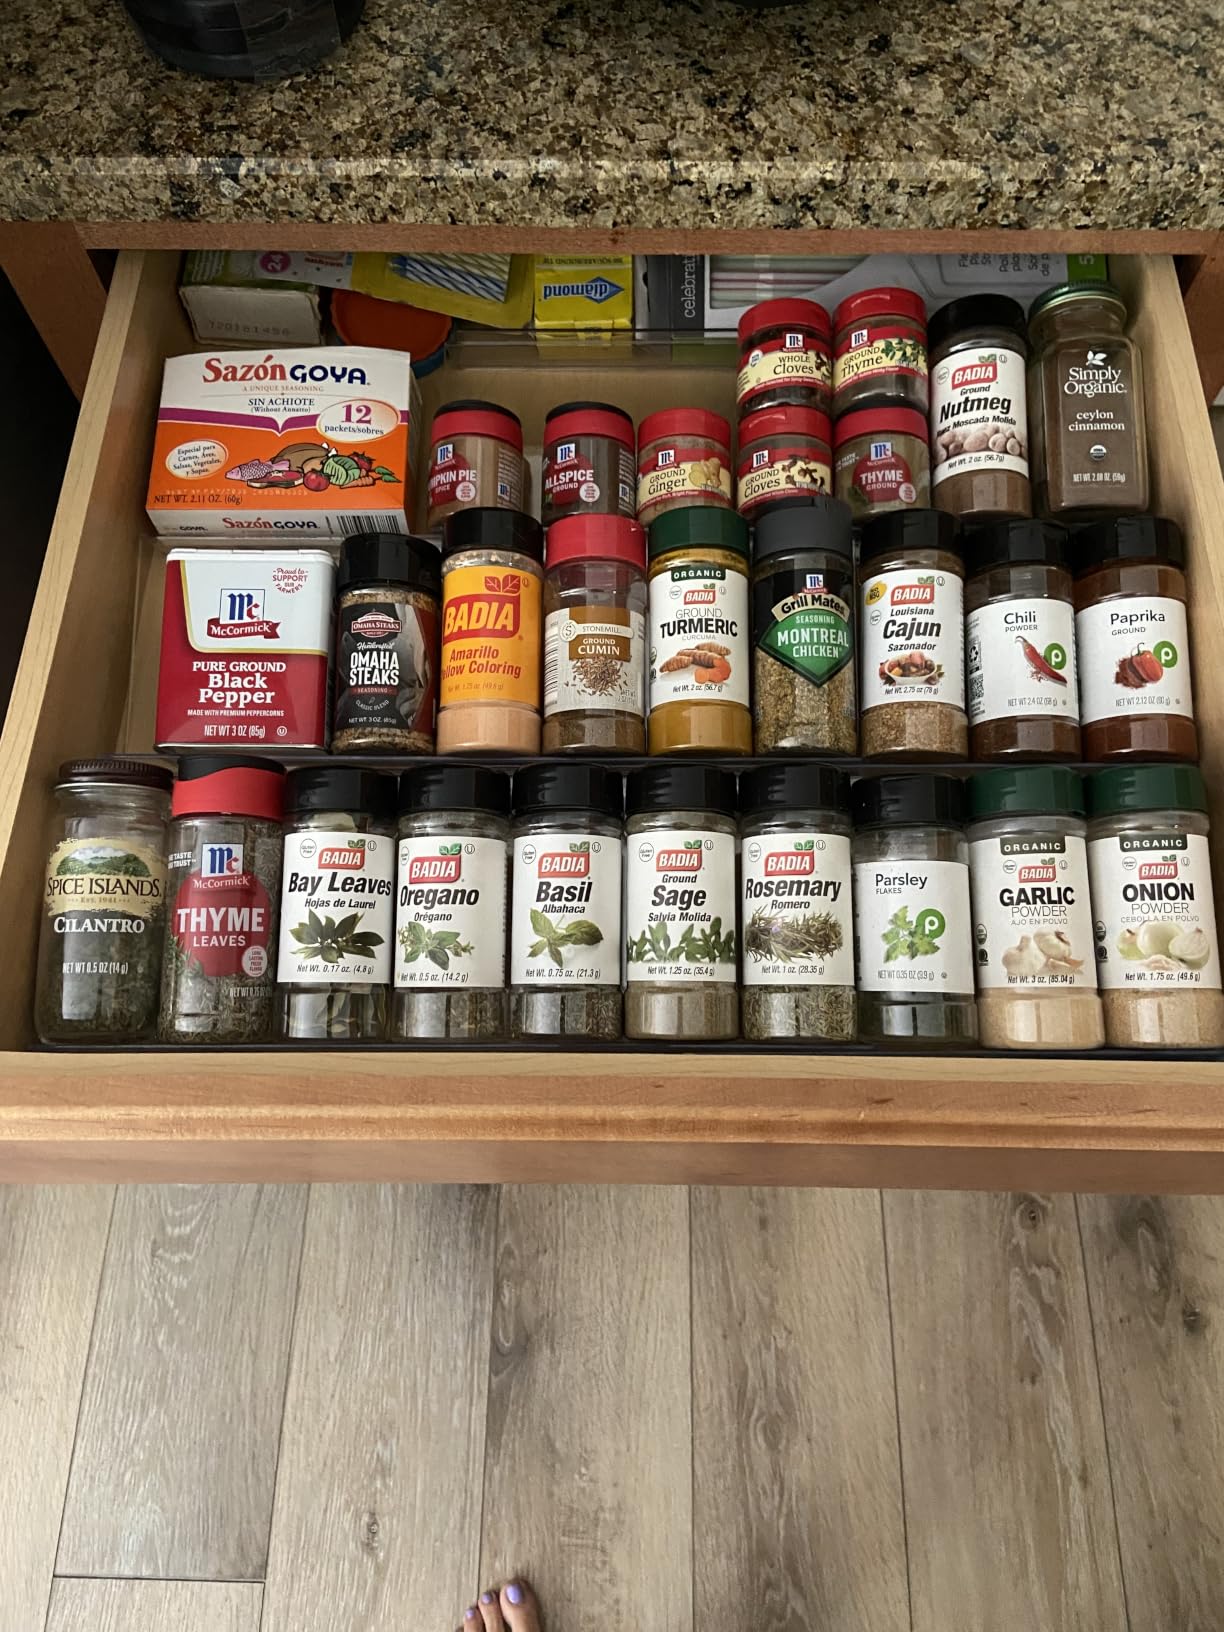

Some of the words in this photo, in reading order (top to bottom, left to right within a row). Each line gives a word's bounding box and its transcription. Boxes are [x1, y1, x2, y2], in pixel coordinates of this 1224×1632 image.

[543, 283, 609, 300] diamond
[778, 355, 810, 364] WHOLE
[844, 346, 881, 366] GROUND
[203, 354, 287, 383] Sazón
[289, 364, 368, 386] GOYA
[773, 363, 814, 375] Cloves
[841, 356, 883, 378] Thyme
[954, 365, 993, 385] BADIA
[1068, 366, 1122, 384] Simply
[960, 385, 991, 396] Ground
[1064, 381, 1125, 398] Organic
[248, 398, 268, 406] SIN
[270, 398, 316, 407] ACHIOTE
[250, 406, 278, 414] (Without
[341, 403, 373, 425] 12
[940, 396, 1012, 424] Nutmeg
[1076, 410, 1113, 422] ceylon
[952, 416, 989, 430] Moscada
[992, 416, 1016, 426] Molida
[1068, 422, 1125, 431] cinnamon
[324, 424, 385, 437] packets/sobres
[458, 469, 478, 482] PIE
[545, 469, 594, 491] ALLSPICE
[649, 469, 686, 485] GROUND
[745, 468, 780, 487] GROUND
[860, 469, 904, 486] THYME
[552, 482, 579, 494] GROUND
[648, 478, 687, 496] Ginger
[744, 478, 781, 499] Cloves
[866, 482, 898, 491] GROUND
[153, 494, 172, 504] NET
[174, 494, 188, 504] WT.
[206, 494, 222, 504] OZ.
[222, 517, 273, 530] Sazón
[273, 518, 317, 530] GOYA
[277, 567, 297, 575] Proud
[673, 570, 722, 579] ORGANIC
[686, 590, 713, 602] BADIA
[893, 587, 931, 602] BADIA
[780, 594, 809, 614] Grill
[811, 594, 845, 616] Mates
[890, 606, 935, 617] Louisiana
[444, 601, 515, 637] BADIA
[675, 607, 723, 619] GROUND
[1004, 611, 1036, 625] Chili
[1110, 610, 1166, 626] Paprika
[353, 621, 376, 630] OMAHA
[377, 621, 399, 629] STEAKS
[795, 615, 835, 625] SEASONING
[210, 623, 272, 636] McCormick
[582, 625, 620, 633] STONEMILL
[660, 618, 738, 639] TURMERIC
[882, 618, 942, 641] Cajun
[1111, 627, 1147, 636] GROUND
[777, 628, 849, 648] MONTREAL
[577, 645, 620, 656] CUMIN
[792, 646, 839, 659] CHICKEN
[887, 642, 937, 652] Sazonador
[350, 651, 400, 670] OMAHA
[450, 646, 499, 662] Amarillo
[192, 661, 227, 672] PURE
[229, 661, 287, 672] GROUND
[469, 660, 521, 680] Coloring
[207, 672, 268, 689] Black
[350, 668, 400, 686] STEAKS
[198, 688, 275, 709] Pepper
[204, 724, 217, 737] NET
[218, 724, 230, 737] WT
[237, 724, 247, 737] OZ
[1003, 842, 1061, 853] ORGANIC
[1123, 839, 1182, 849] ORGANIC
[174, 851, 193, 861] TASTE
[321, 850, 361, 866] BADIA
[659, 853, 699, 868] BADIA
[411, 860, 456, 879] BADIA
[541, 856, 586, 873] BADIA
[766, 855, 811, 873] BADIA
[1021, 867, 1053, 881] BADIA
[1142, 865, 1175, 878] BADIA
[192, 876, 250, 889] McCormick
[288, 872, 323, 897] Bay
[327, 871, 392, 897] Leaves
[661, 874, 698, 884] Ground
[875, 872, 928, 890] Parsley
[47, 877, 85, 897] SPICE
[89, 878, 162, 897] ISLANDS
[535, 881, 593, 903] Basil
[745, 878, 842, 902] Rosemary
[875, 887, 902, 895] FLAKES
[1122, 882, 1195, 902] ONION
[400, 885, 480, 910] Oregano
[651, 885, 707, 911] Sage
[999, 886, 1076, 907] GARLIC
[304, 898, 330, 910] Hojas
[333, 899, 346, 908] de
[348, 899, 377, 910] Laurel
[541, 904, 586, 914] Albahaca
[771, 899, 811, 910] Romero
[1131, 902, 1190, 914] POWDER
[414, 912, 453, 924] Orégano
[647, 912, 676, 923] Salvia
[678, 912, 712, 923] Molida
[1011, 905, 1068, 918] POWDER
[54, 917, 145, 934] CILANTRO
[177, 907, 265, 933] THYME
[1010, 918, 1027, 926] AJO
[1120, 916, 1159, 924] CEBOLLA
[193, 935, 246, 947] LEAVES
[62, 962, 74, 974] NET
[75, 962, 87, 974] WT
[99, 962, 109, 974] OZ
[120, 962, 129, 975] g)
[525, 969, 535, 978] Net
[536, 969, 546, 977] Wt.
[564, 970, 575, 978] oz.
[595, 970, 602, 979] g)
[1007, 975, 1018, 984] Net
[1019, 975, 1030, 983] Wt.
[1069, 975, 1075, 985] g)
